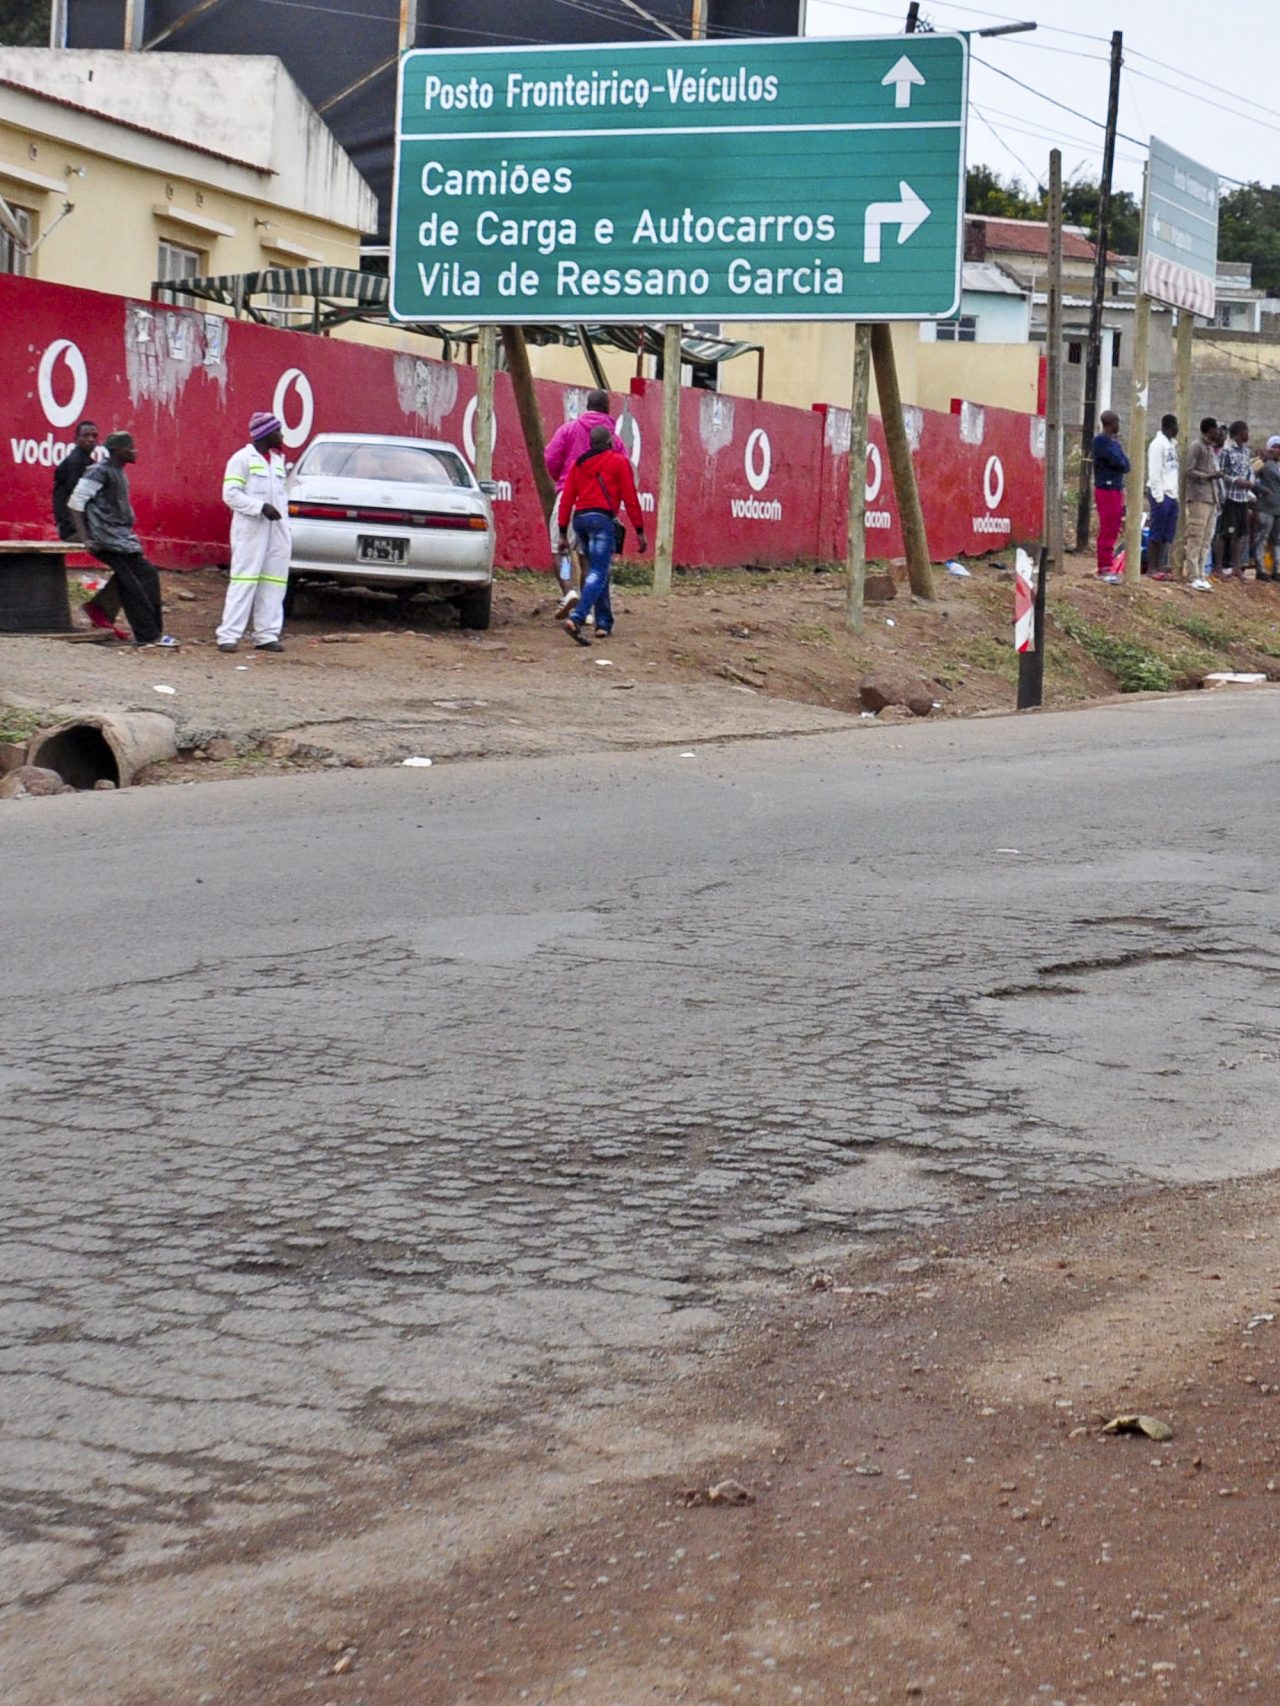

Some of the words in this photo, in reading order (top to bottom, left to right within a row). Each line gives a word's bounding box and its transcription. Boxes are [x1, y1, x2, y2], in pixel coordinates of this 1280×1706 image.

[424, 75, 494, 110] Posto
[418, 212, 459, 247] de
[476, 210, 577, 255] Carga
[594, 218, 614, 245] e
[632, 207, 836, 244] Autocarros
[417, 262, 480, 297] Vila
[497, 261, 540, 296] de
[557, 260, 710, 296] Ressano
[727, 258, 844, 295] Garcia
[730, 494, 782, 521] vodacom
[864, 510, 891, 528] acom
[972, 511, 1011, 534] vodacom
